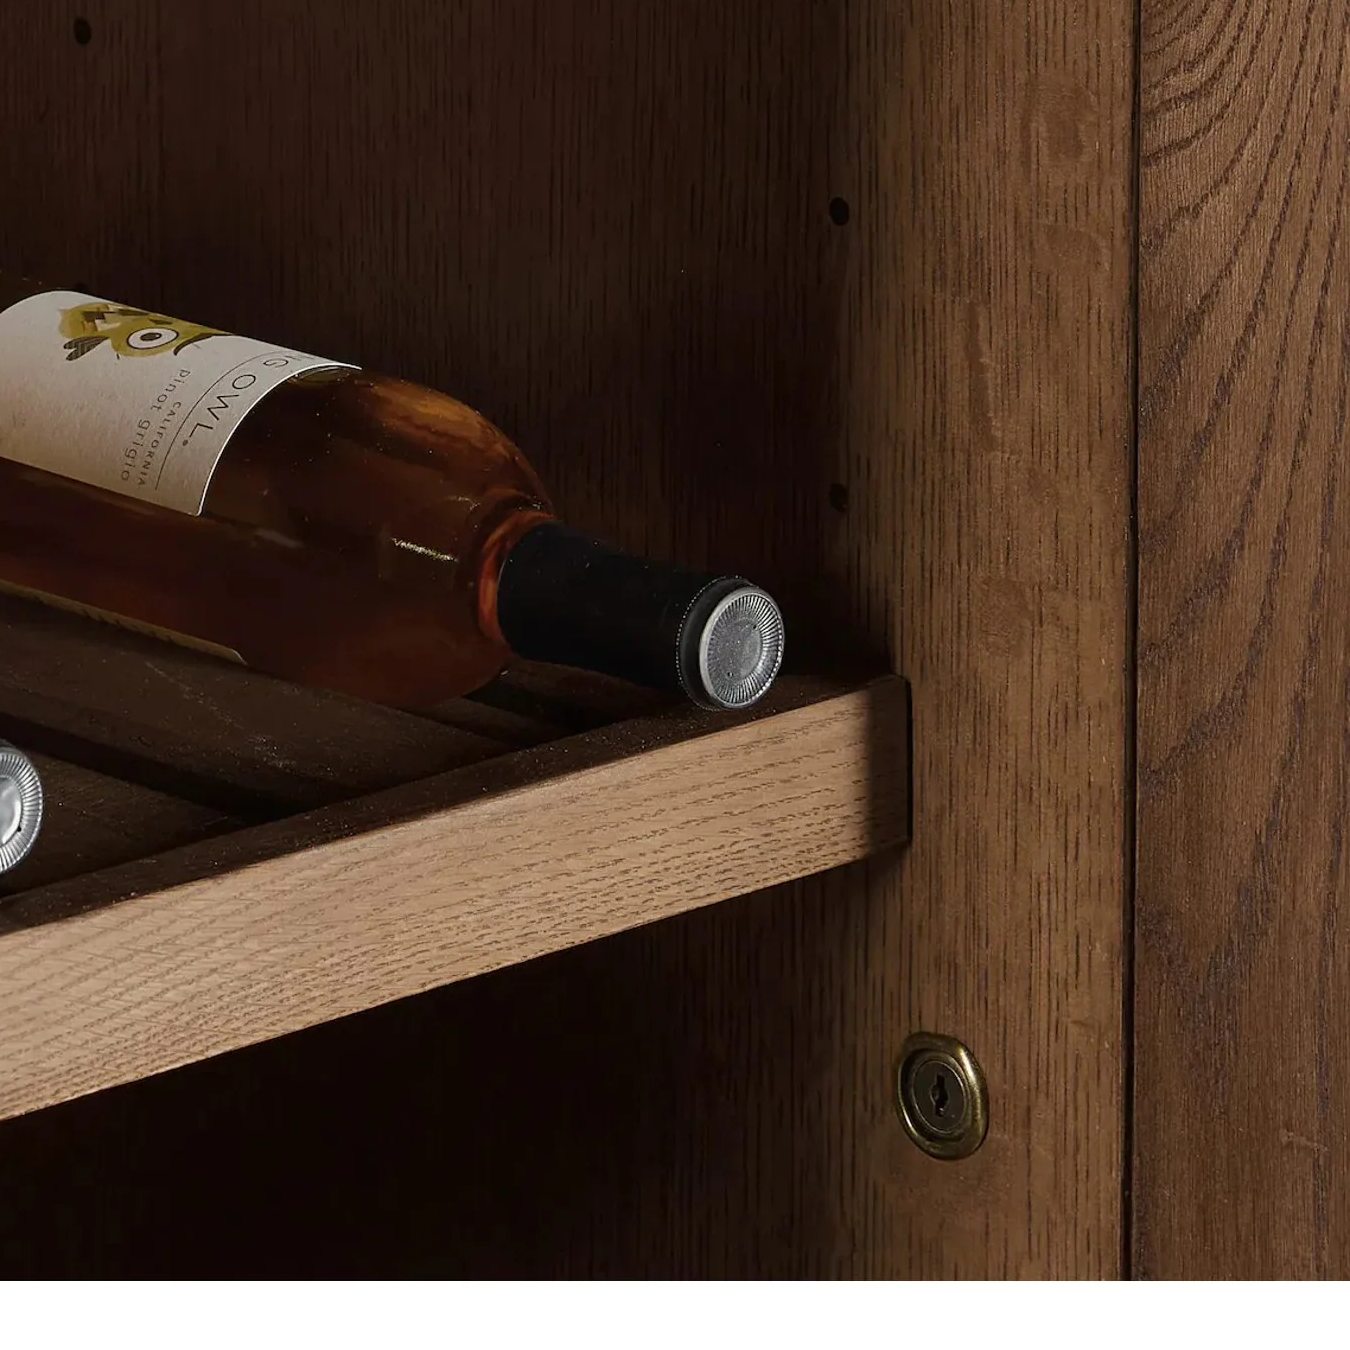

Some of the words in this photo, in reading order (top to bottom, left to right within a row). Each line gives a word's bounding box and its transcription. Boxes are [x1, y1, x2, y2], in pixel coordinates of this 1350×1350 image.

[150, 369, 191, 411] pinot
[120, 419, 151, 482] grigio
[137, 401, 181, 486] CALIFORNIA
